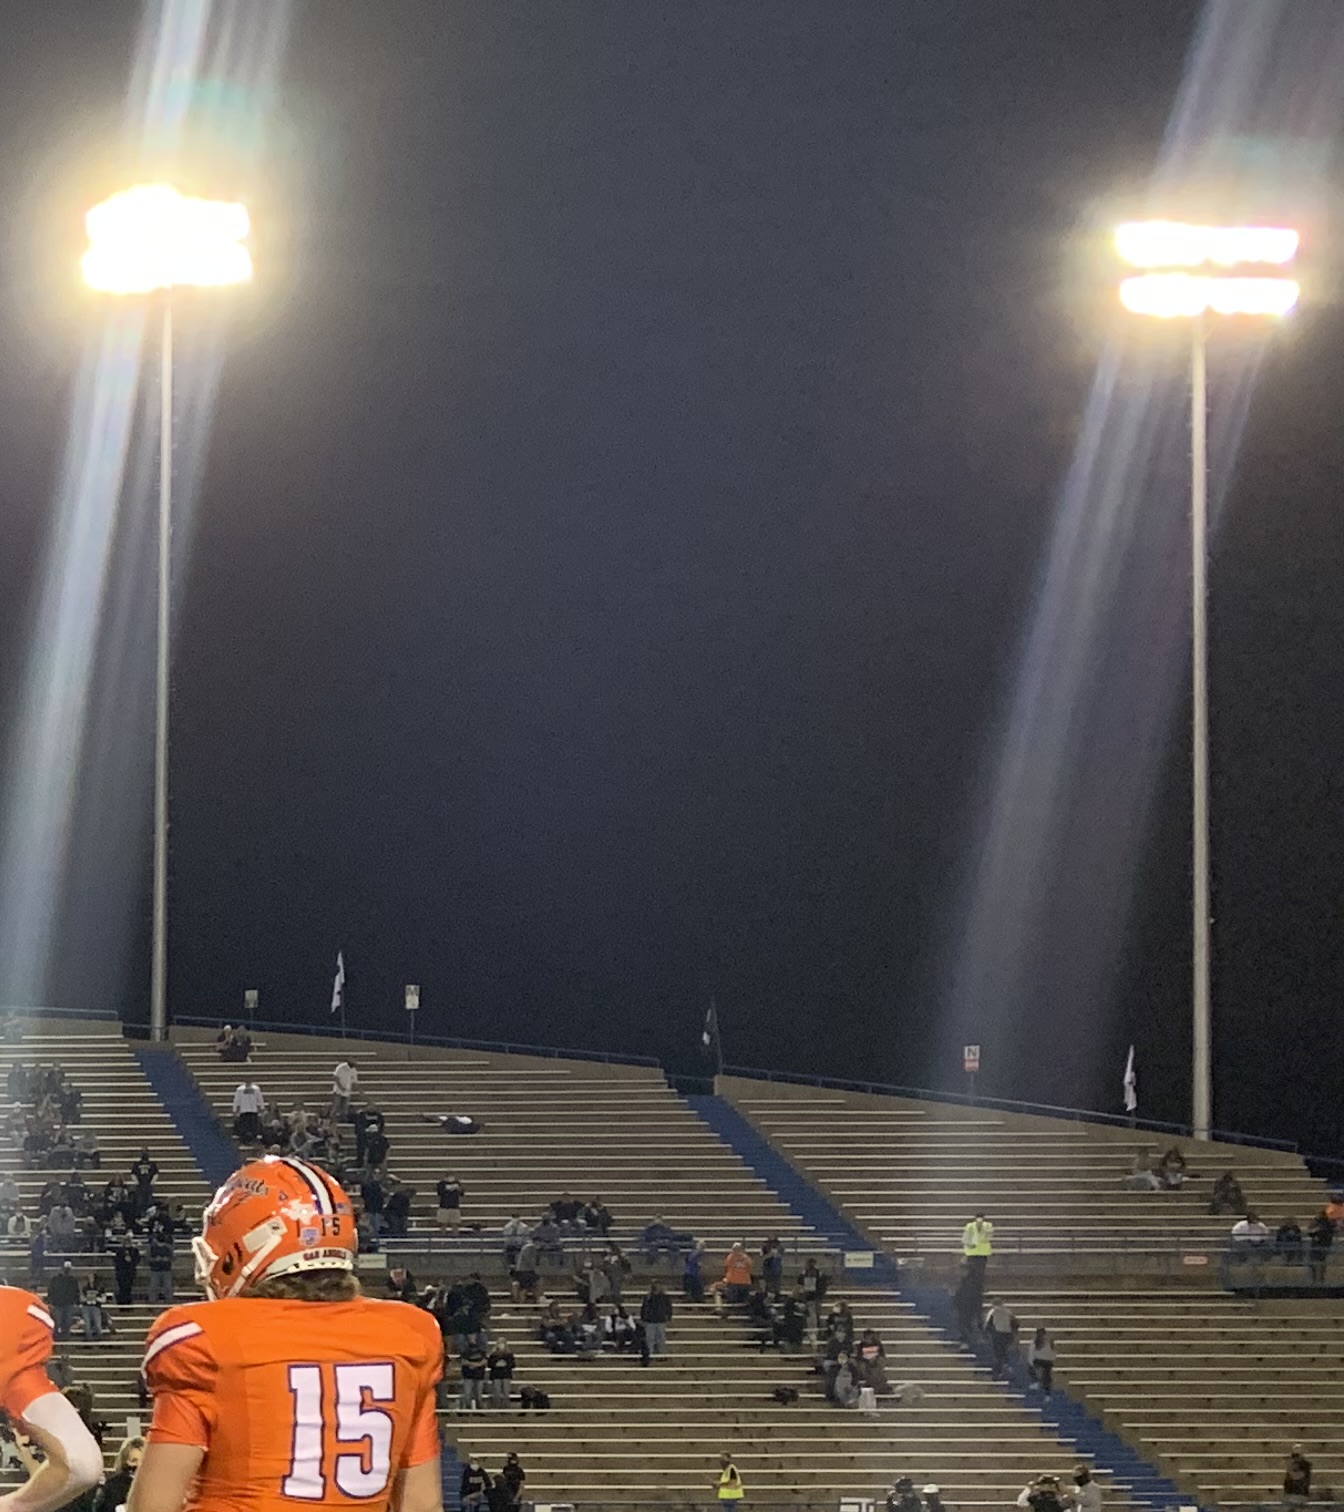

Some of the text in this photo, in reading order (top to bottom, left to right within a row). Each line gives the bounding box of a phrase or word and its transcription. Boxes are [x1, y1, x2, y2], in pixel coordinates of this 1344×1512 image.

[321, 1217, 340, 1236] 15
[303, 1251, 319, 1261] SAN
[281, 1362, 396, 1500] 15
